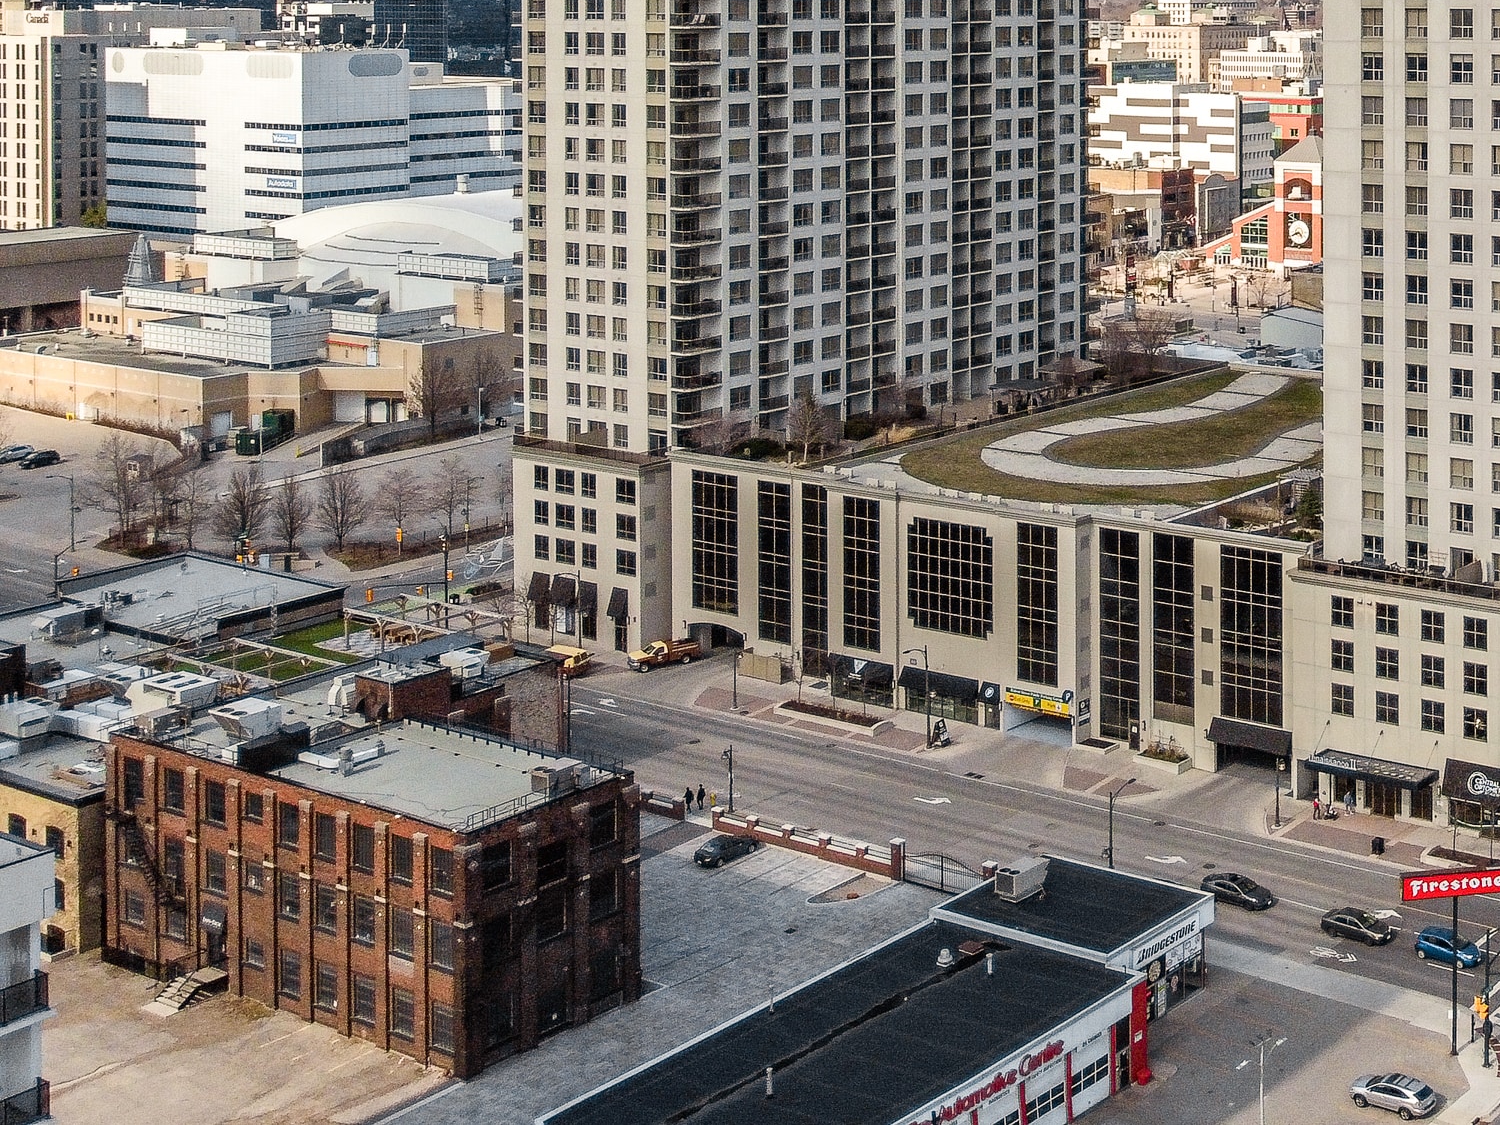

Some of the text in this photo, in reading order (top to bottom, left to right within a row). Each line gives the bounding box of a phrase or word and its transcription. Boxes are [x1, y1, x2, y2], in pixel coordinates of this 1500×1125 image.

[26, 13, 49, 23] Canada
[1475, 777, 1500, 787] CENTRAL
[1136, 920, 1196, 965] BRIDGESTONE
[937, 1039, 1065, 1123] Automotive Centre
